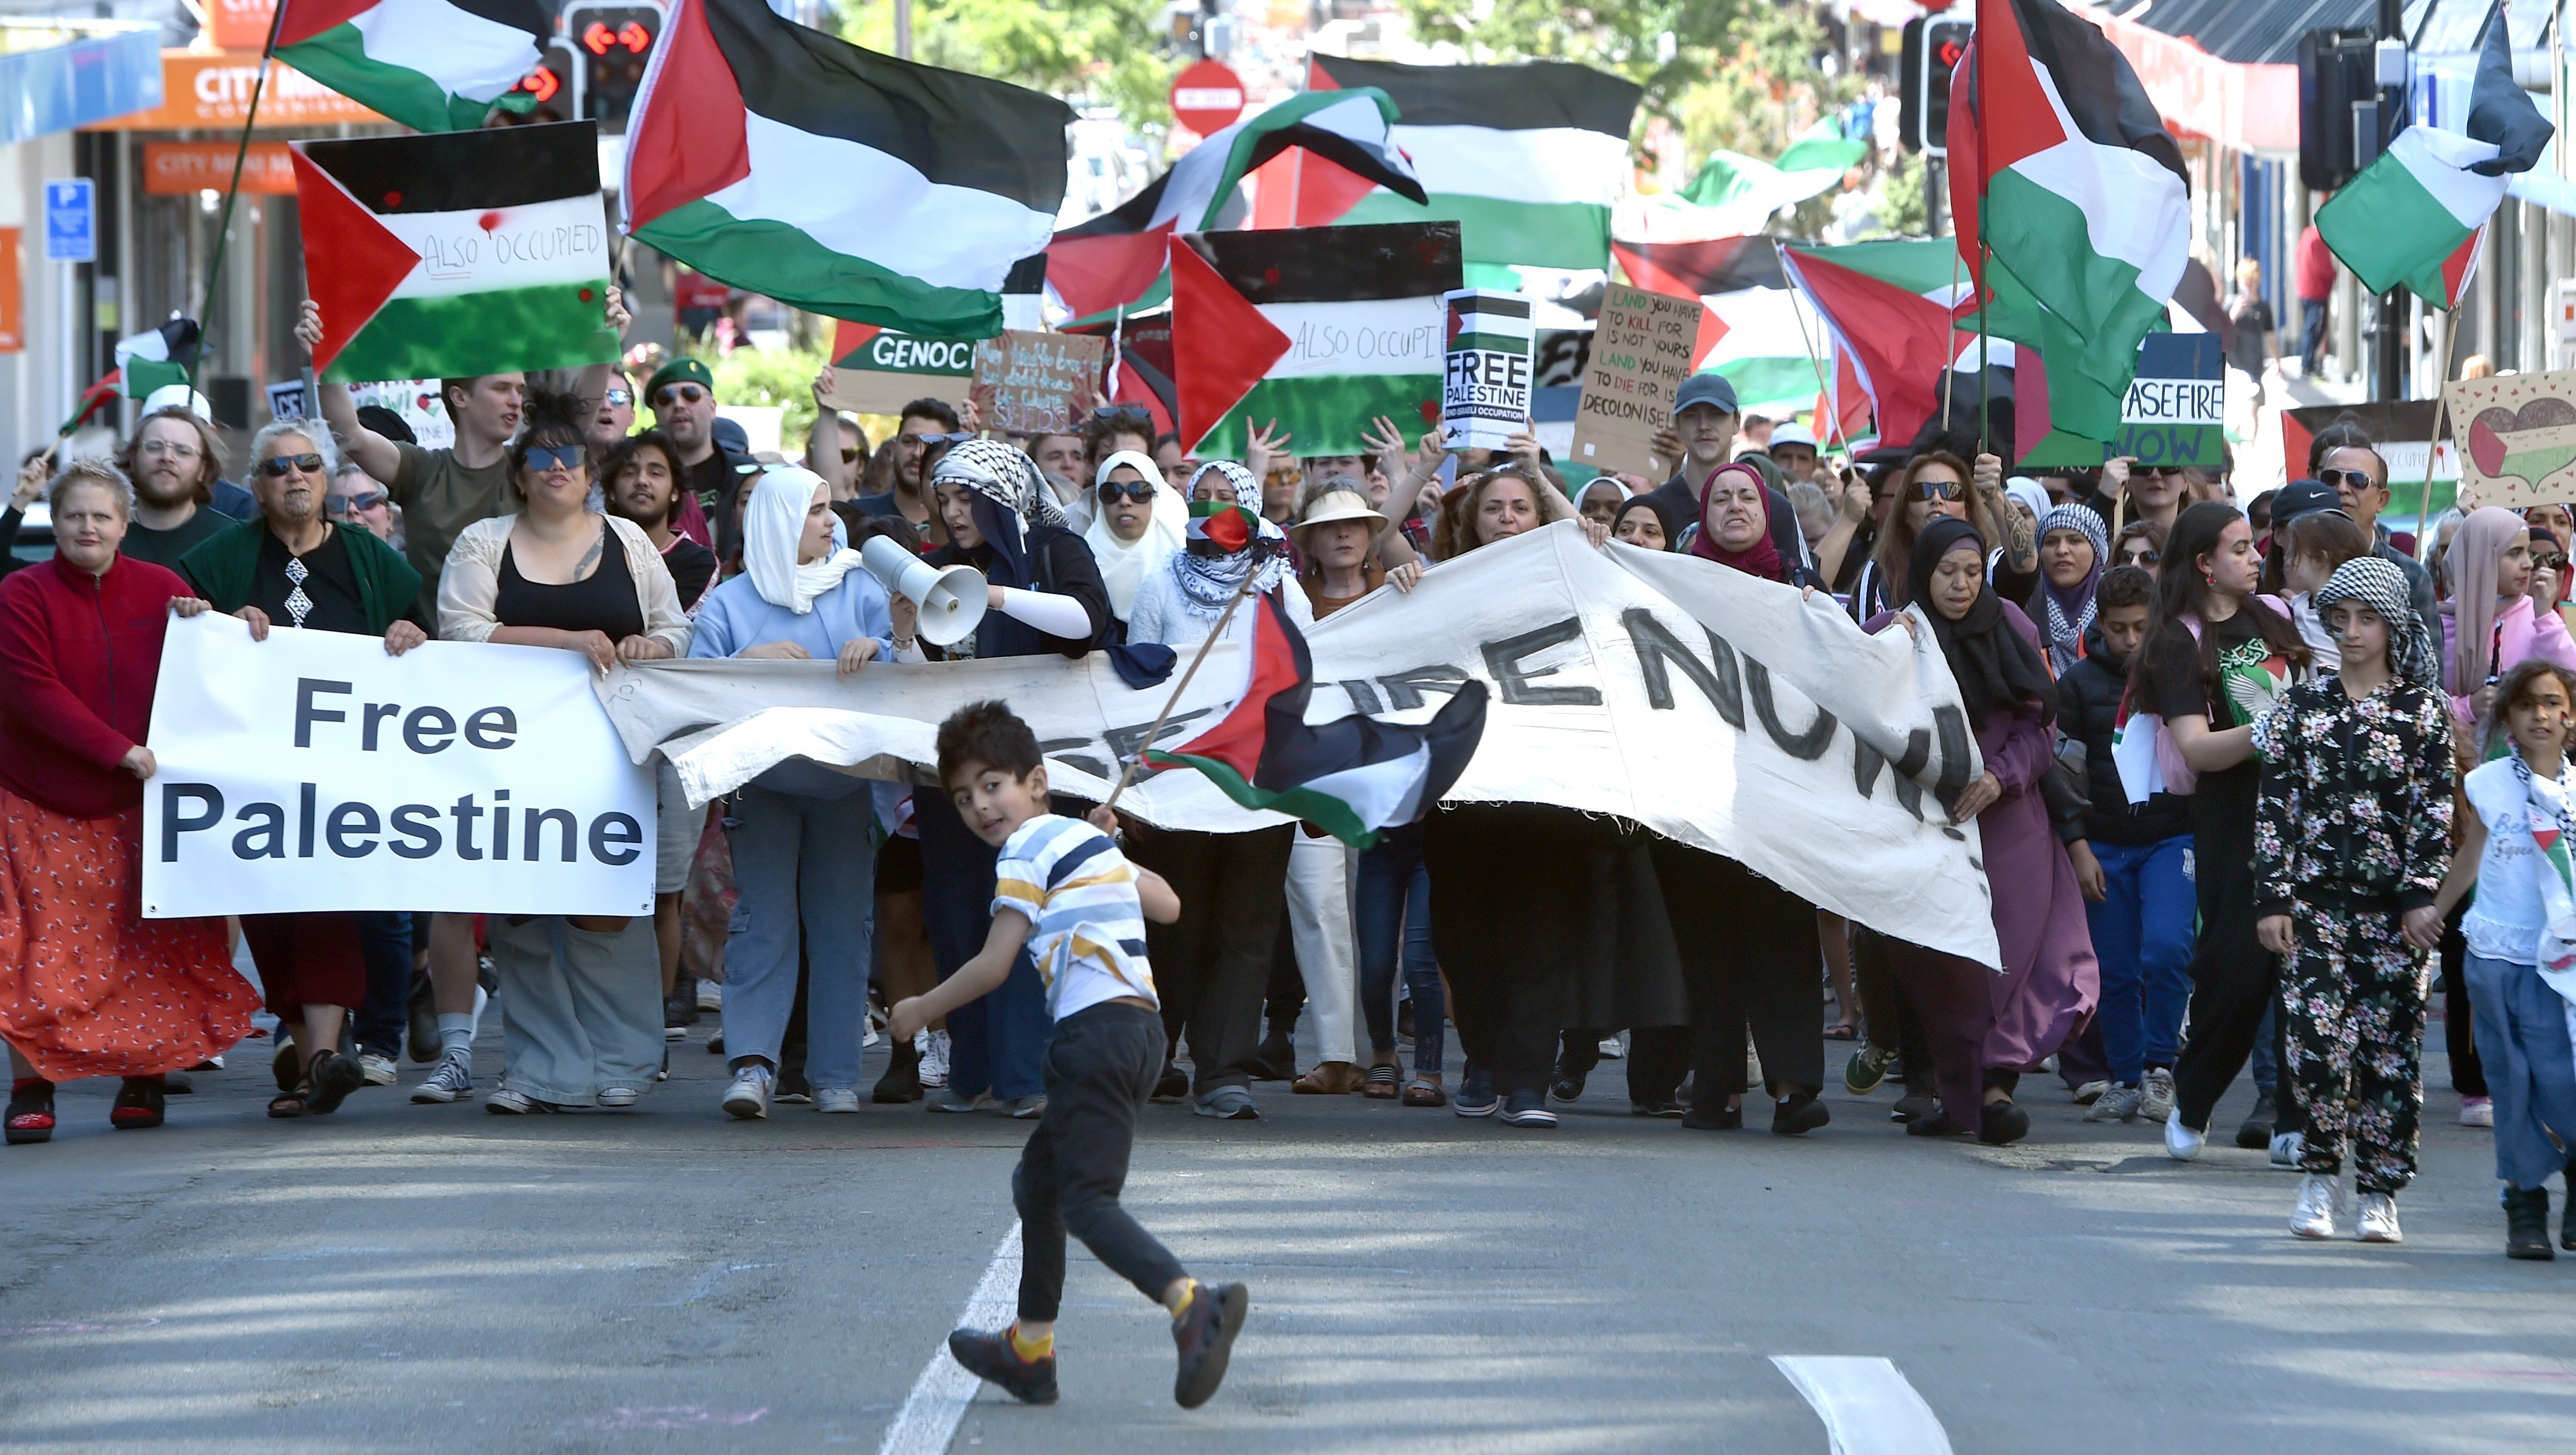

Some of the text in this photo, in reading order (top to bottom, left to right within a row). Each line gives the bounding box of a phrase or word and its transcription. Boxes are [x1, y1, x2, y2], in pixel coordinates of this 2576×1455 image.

[424, 224, 600, 274] ALSO OCCUPIED
[1613, 291, 1647, 309] LAND
[1674, 305, 1701, 322] HAVE
[1607, 310, 1683, 338] TO KILL FOR
[873, 335, 977, 370] GENOC
[1292, 321, 1443, 361] ALSO OCCUPI
[1607, 328, 1690, 359] IS NOT YOURS
[1446, 352, 1528, 389] FREE
[1599, 350, 1636, 370] LAND
[1662, 365, 1691, 382] HAVE
[1446, 385, 1526, 407] PALESTINE
[1593, 370, 1675, 403] TO DIE FOR IS
[2122, 382, 2223, 420] ASEFIRE
[991, 403, 1070, 435] SEEDS
[1457, 406, 1477, 415] ISRAELI
[1478, 406, 1523, 420] OCCUPATION
[2384, 452, 2437, 468] OCCUPIE
[294, 677, 518, 755] Free
[161, 782, 643, 866] Palestine
